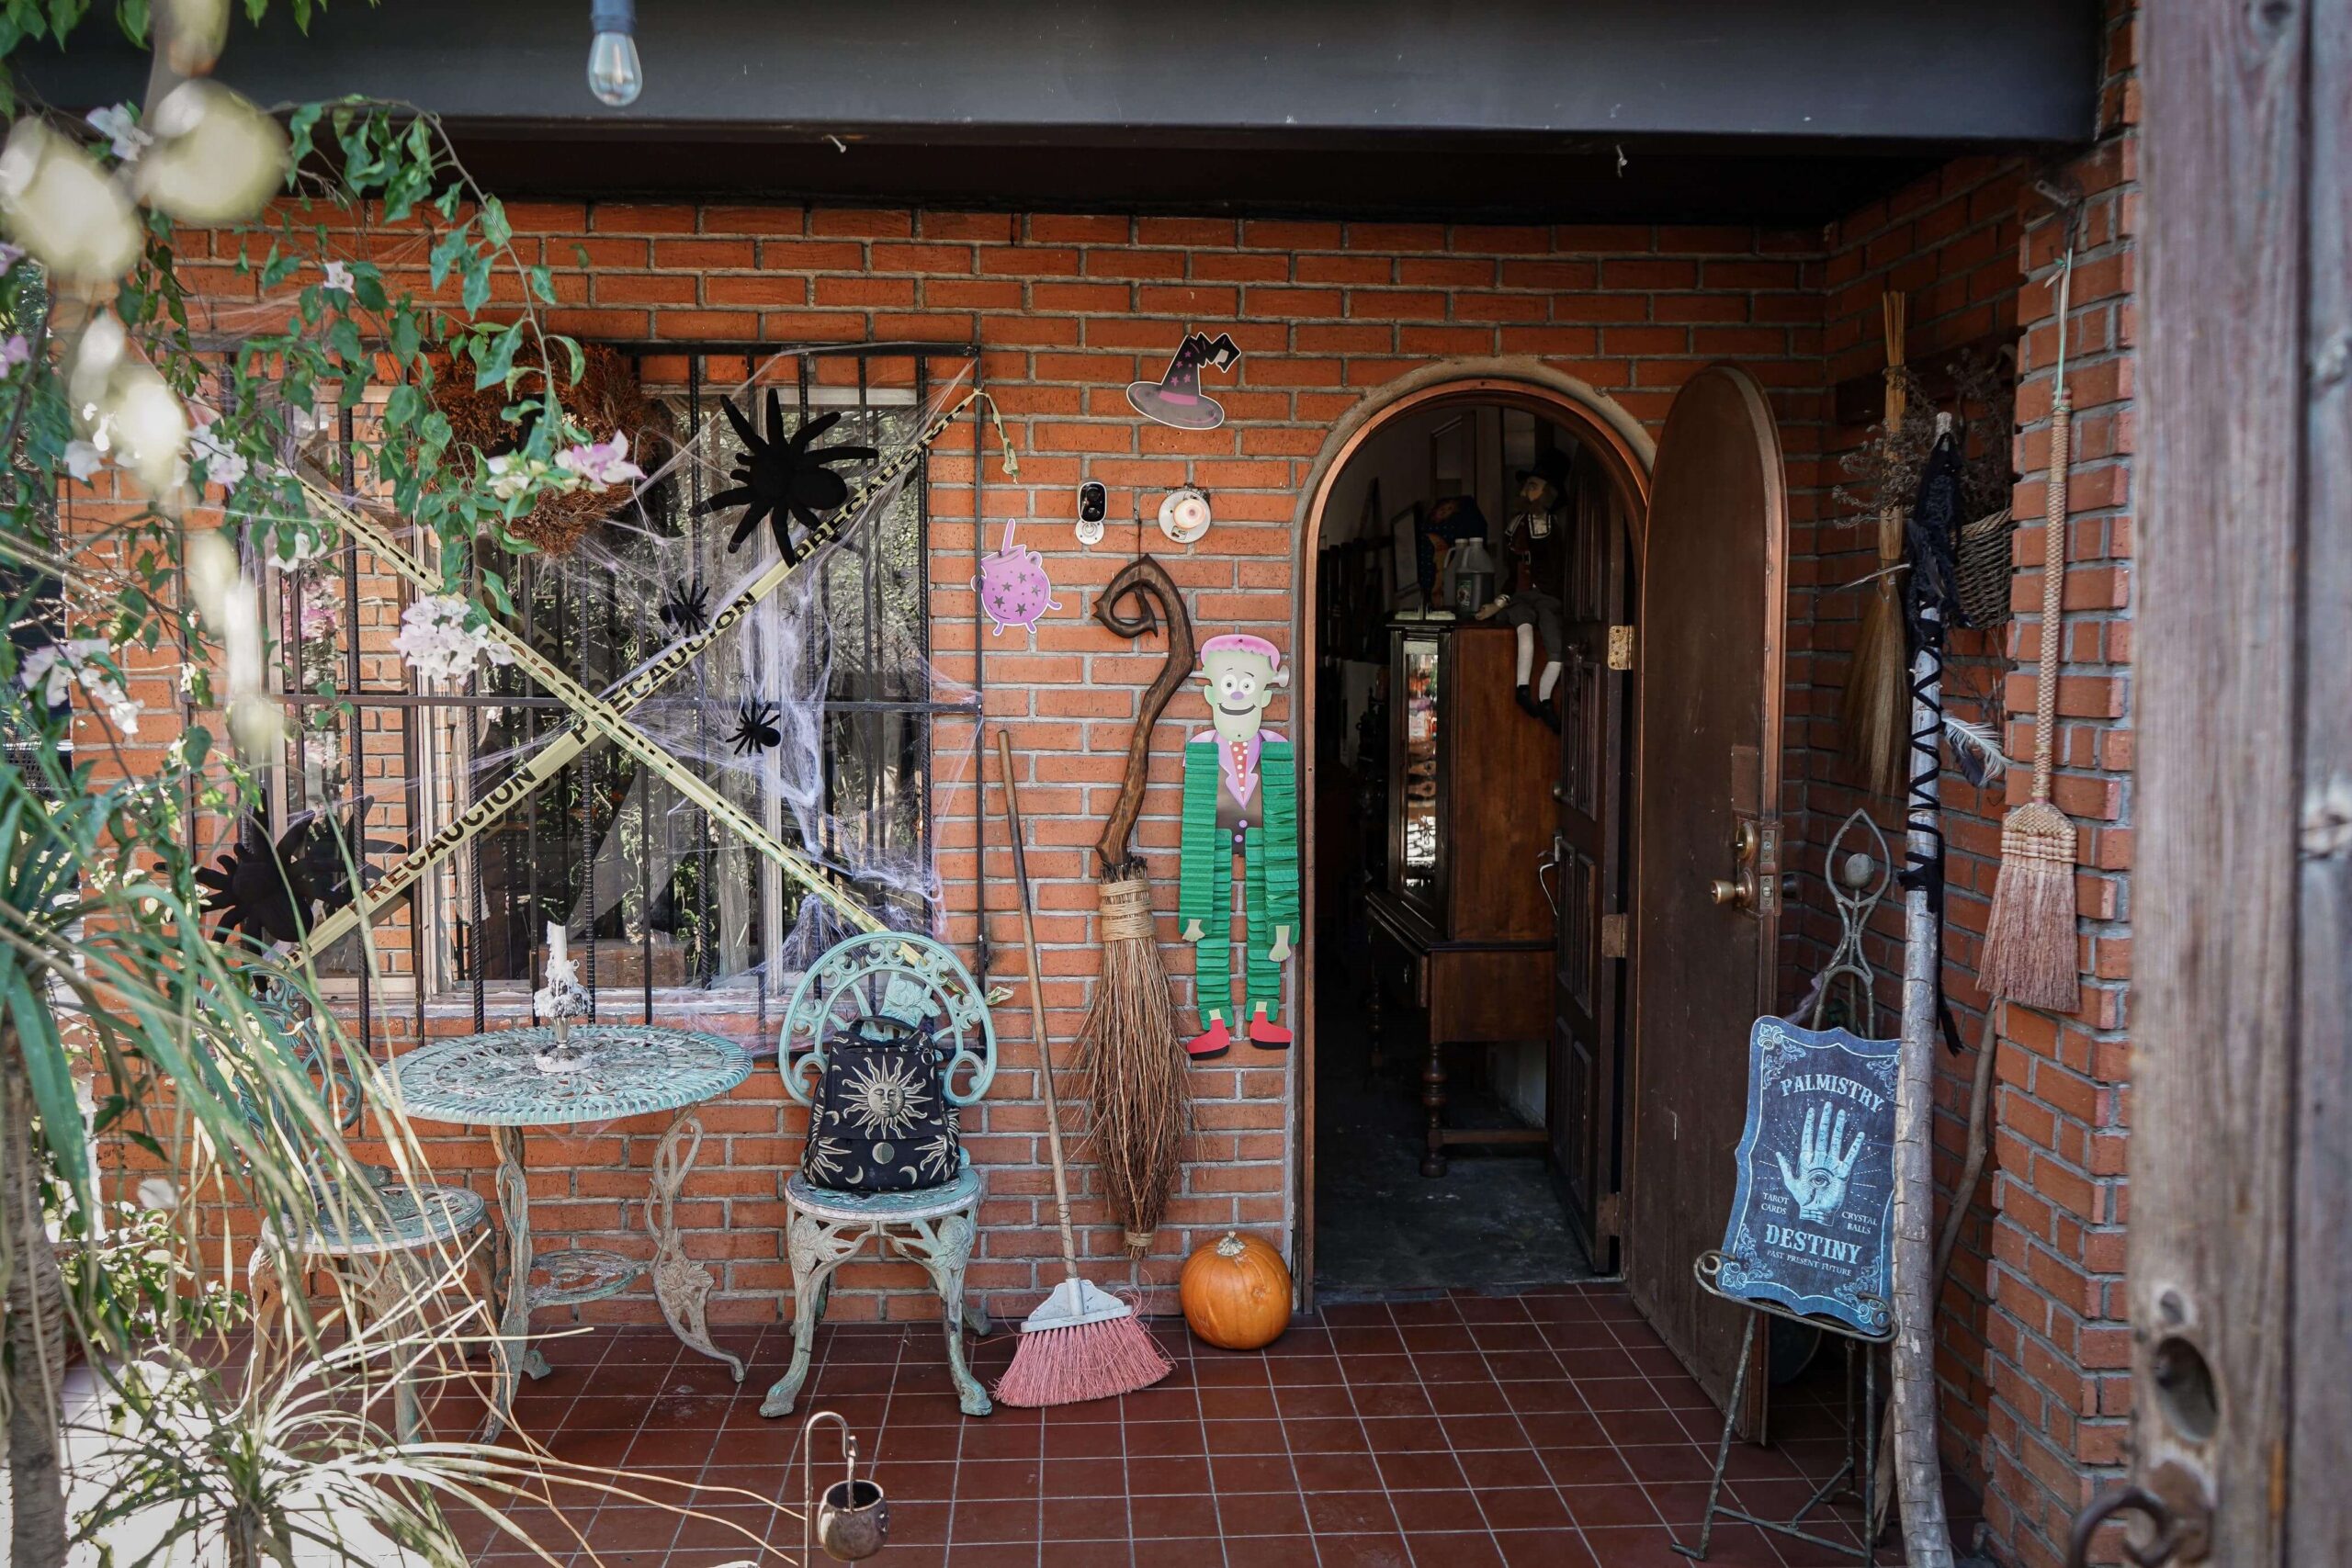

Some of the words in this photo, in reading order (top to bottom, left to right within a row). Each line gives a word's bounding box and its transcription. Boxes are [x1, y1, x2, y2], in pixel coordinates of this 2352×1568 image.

[571, 591, 757, 746] PECAUCION
[1780, 1073, 1885, 1113] PALMISTRY
[1760, 1202, 1787, 1215] CARDS
[1762, 1191, 1790, 1205] TAROT
[1841, 1211, 1878, 1226] CRYSTAL
[1847, 1223, 1871, 1235] BALLS
[1764, 1224, 1863, 1265] DESTINY
[1767, 1249, 1784, 1259] PAST
[1786, 1253, 1819, 1269] PRESENT
[1821, 1262, 1852, 1277] FUTURE
